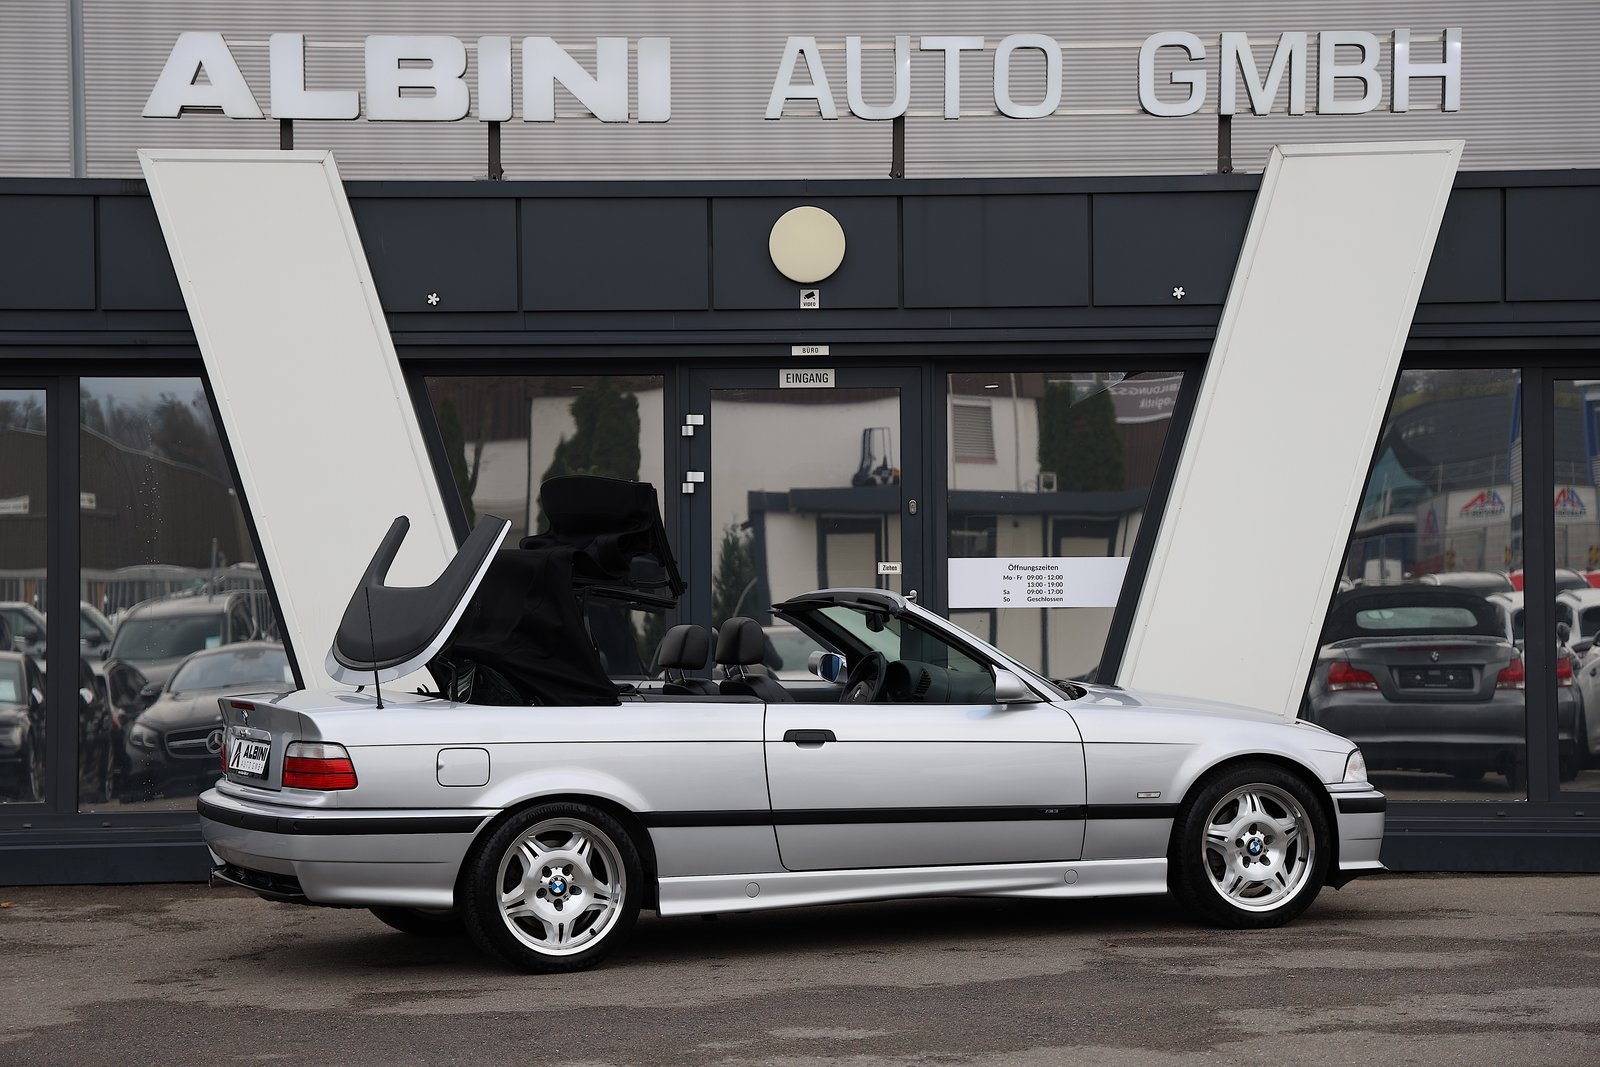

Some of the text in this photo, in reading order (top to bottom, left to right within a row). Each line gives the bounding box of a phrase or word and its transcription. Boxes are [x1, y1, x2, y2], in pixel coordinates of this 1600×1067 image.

[142, 27, 1463, 123] ALBINI AUTO GMBH
[786, 373, 829, 384] EINGANG
[1008, 564, 1059, 572] Öffnungszeiten
[243, 745, 268, 761] ALBINI
